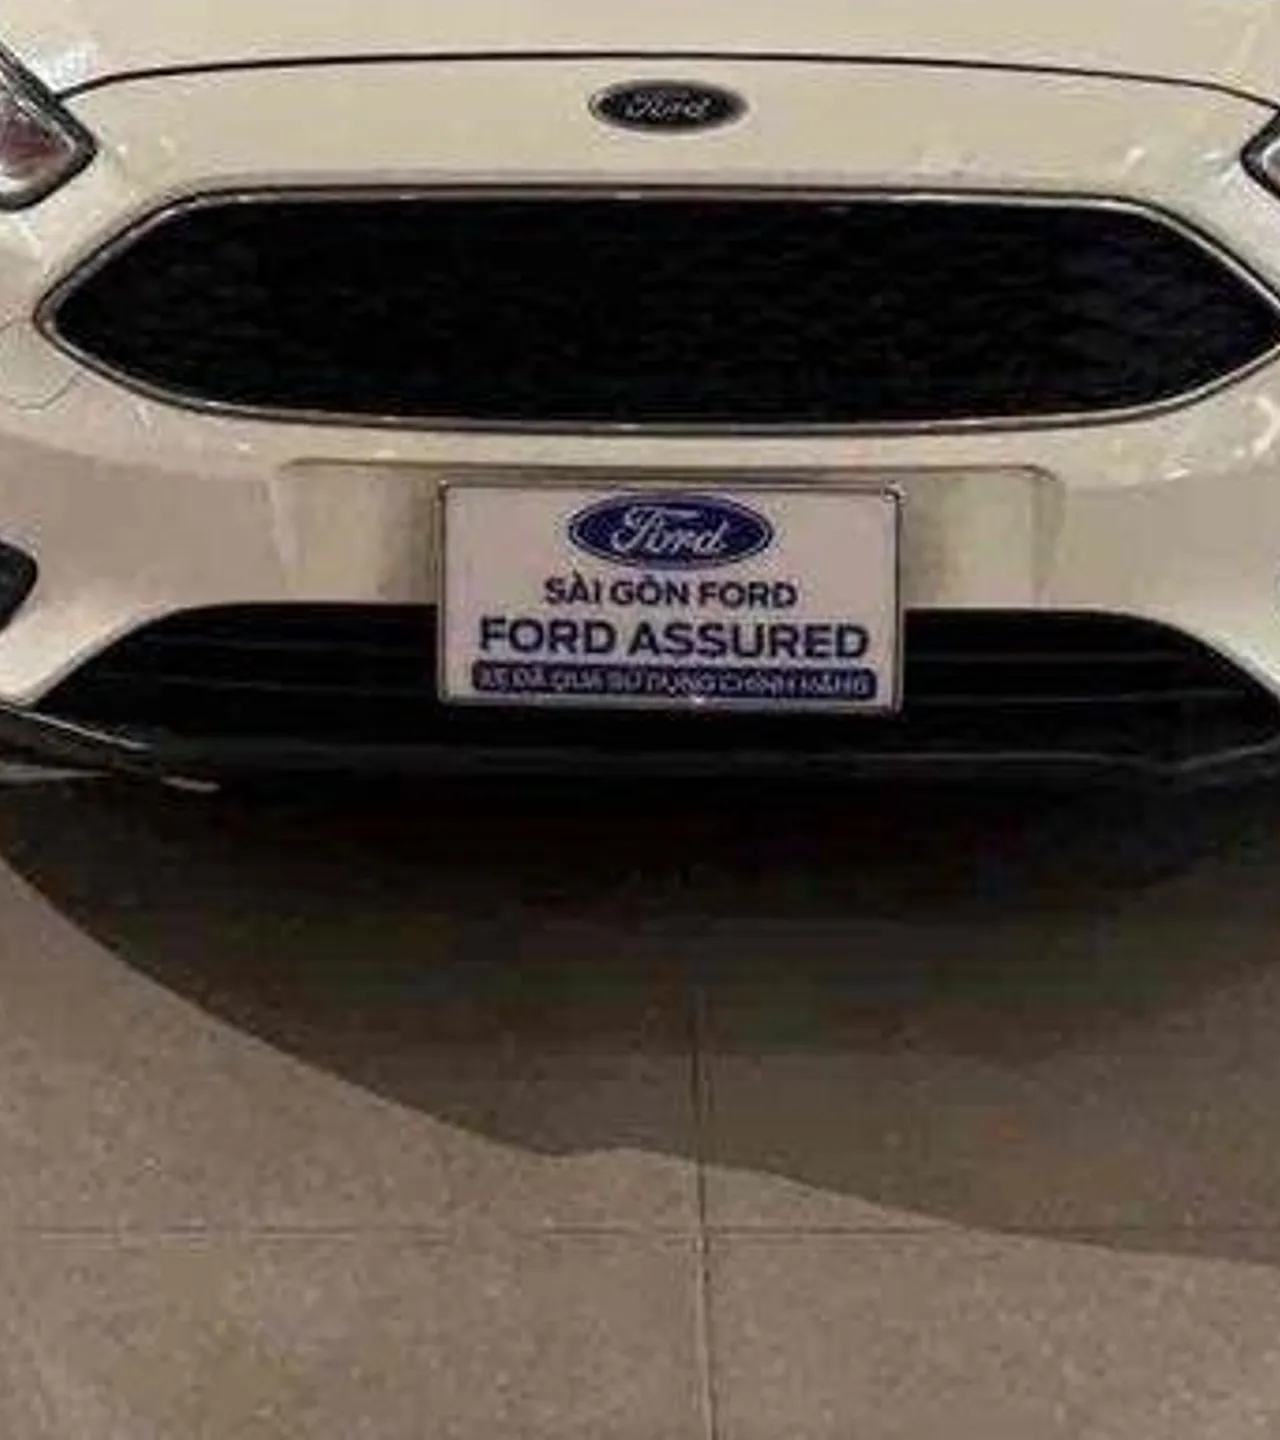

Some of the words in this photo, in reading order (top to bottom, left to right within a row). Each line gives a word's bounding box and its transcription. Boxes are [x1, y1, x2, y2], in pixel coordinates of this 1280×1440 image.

[624, 90, 713, 122] Ford
[611, 506, 729, 554] Ford
[543, 569, 602, 605] SÀI
[698, 580, 799, 610] FORD
[479, 616, 617, 655] FORD
[627, 621, 870, 660] ASSURED
